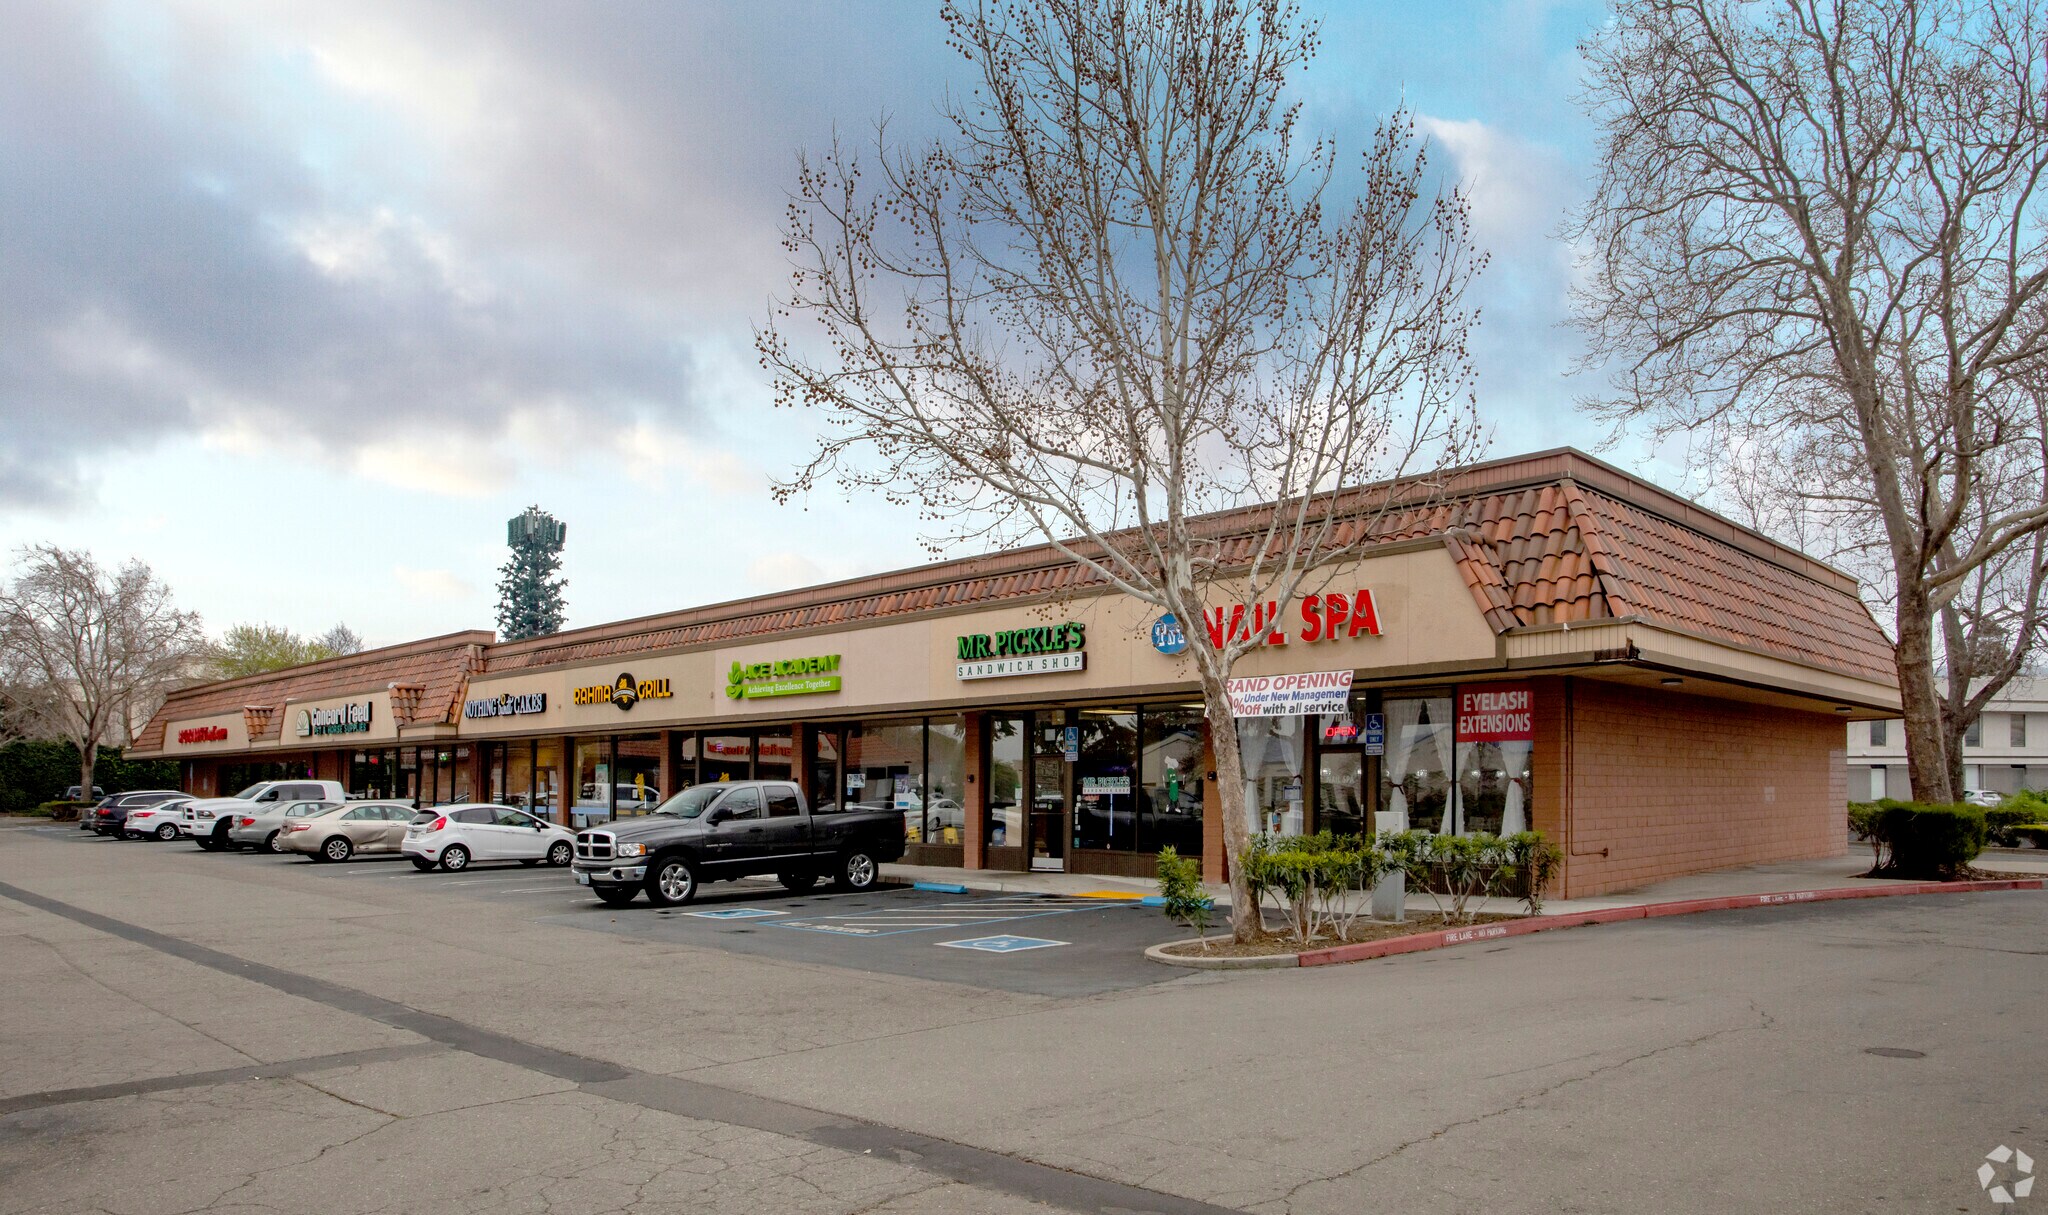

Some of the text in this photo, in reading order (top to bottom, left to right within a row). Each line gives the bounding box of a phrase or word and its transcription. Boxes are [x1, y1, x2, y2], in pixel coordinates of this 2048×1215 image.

[1203, 589, 1382, 650] NAIL SPA
[956, 621, 1084, 660] MR. PICKLE'S
[745, 655, 841, 680] ACE ACADEMY
[958, 655, 1080, 677] SANDWICH SHOP
[573, 685, 612, 705] RAHMA
[637, 678, 671, 699] GRILL
[748, 679, 831, 695] Achieving Excellence Together
[1226, 671, 1352, 693] RAND OPENING
[464, 697, 497, 718] NOTHING
[513, 693, 544, 714] CAKES
[1244, 689, 1348, 703] Under New Managemen
[1463, 690, 1528, 712] EYELASH
[311, 701, 371, 727] Concord Feed
[1262, 703, 1286, 715] with
[1288, 702, 1302, 714] all
[1303, 700, 1344, 713] service
[1326, 726, 1357, 737] OPEN
[1460, 712, 1531, 734] EXTENSIONS
[1446, 932, 1459, 942] FIRE
[1459, 930, 1473, 941] LANE
[1478, 928, 1486, 937] NO
[1487, 927, 1507, 937] PARKING
